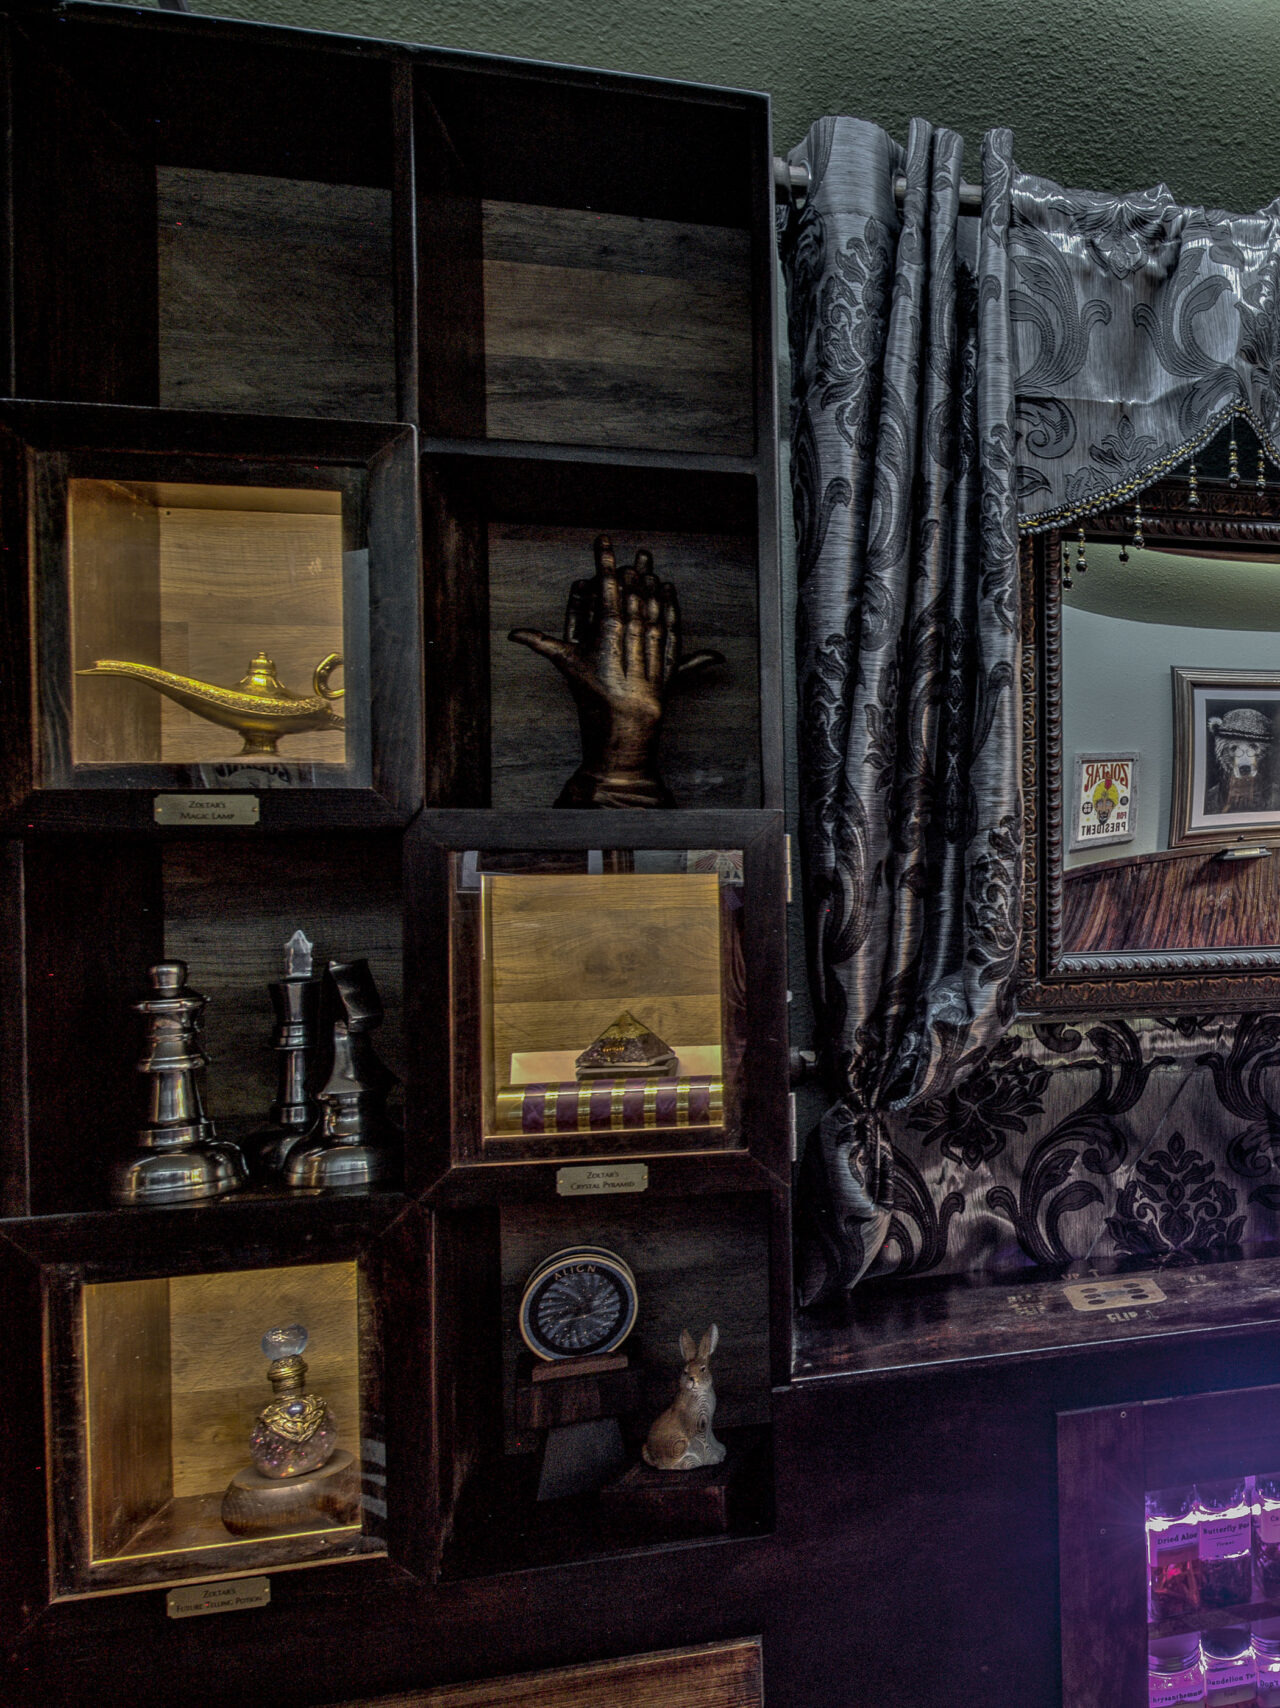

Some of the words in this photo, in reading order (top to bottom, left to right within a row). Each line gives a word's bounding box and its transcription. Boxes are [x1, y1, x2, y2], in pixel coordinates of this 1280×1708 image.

[180, 812, 209, 820] MAGIC
[211, 812, 235, 820] LAMP
[570, 1182, 600, 1191] CRYSTAL
[553, 1264, 597, 1281] ALIGN
[1106, 1311, 1138, 1323] FLIP
[1203, 1524, 1237, 1535] Butterfly
[1157, 1534, 1179, 1545] Dried
[176, 1603, 203, 1613] FUTURE
[204, 1600, 233, 1609] TELLING
[235, 1596, 262, 1605] POTION
[1259, 1679, 1279, 1689] Don't
